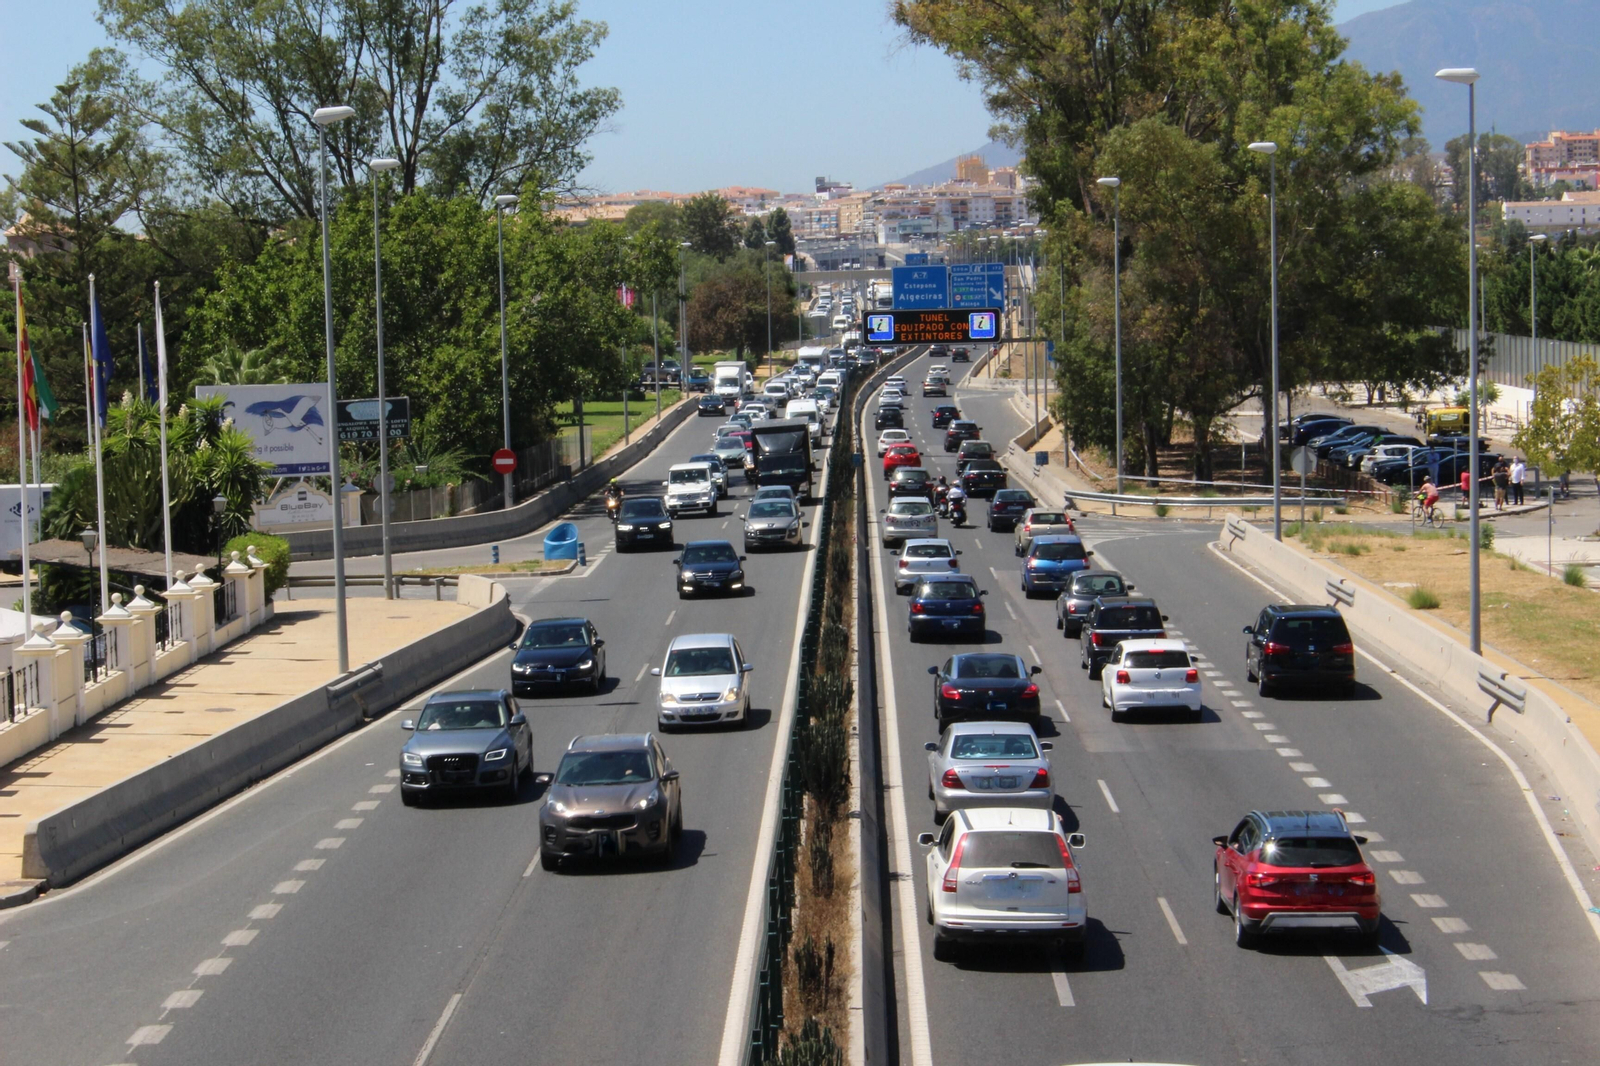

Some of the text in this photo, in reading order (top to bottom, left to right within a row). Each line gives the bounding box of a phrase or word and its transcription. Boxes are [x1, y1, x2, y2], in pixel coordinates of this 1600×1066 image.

[899, 293, 943, 302] Algeciras
[920, 313, 950, 321] TUNEL
[894, 322, 969, 332] EQUIPADO CON
[900, 332, 963, 341] EXTINTORES
[340, 431, 358, 439] 619
[361, 430, 373, 438] 70
[389, 428, 402, 436] 00
[269, 443, 294, 455] possible
[280, 502, 324, 511] BlueBay
